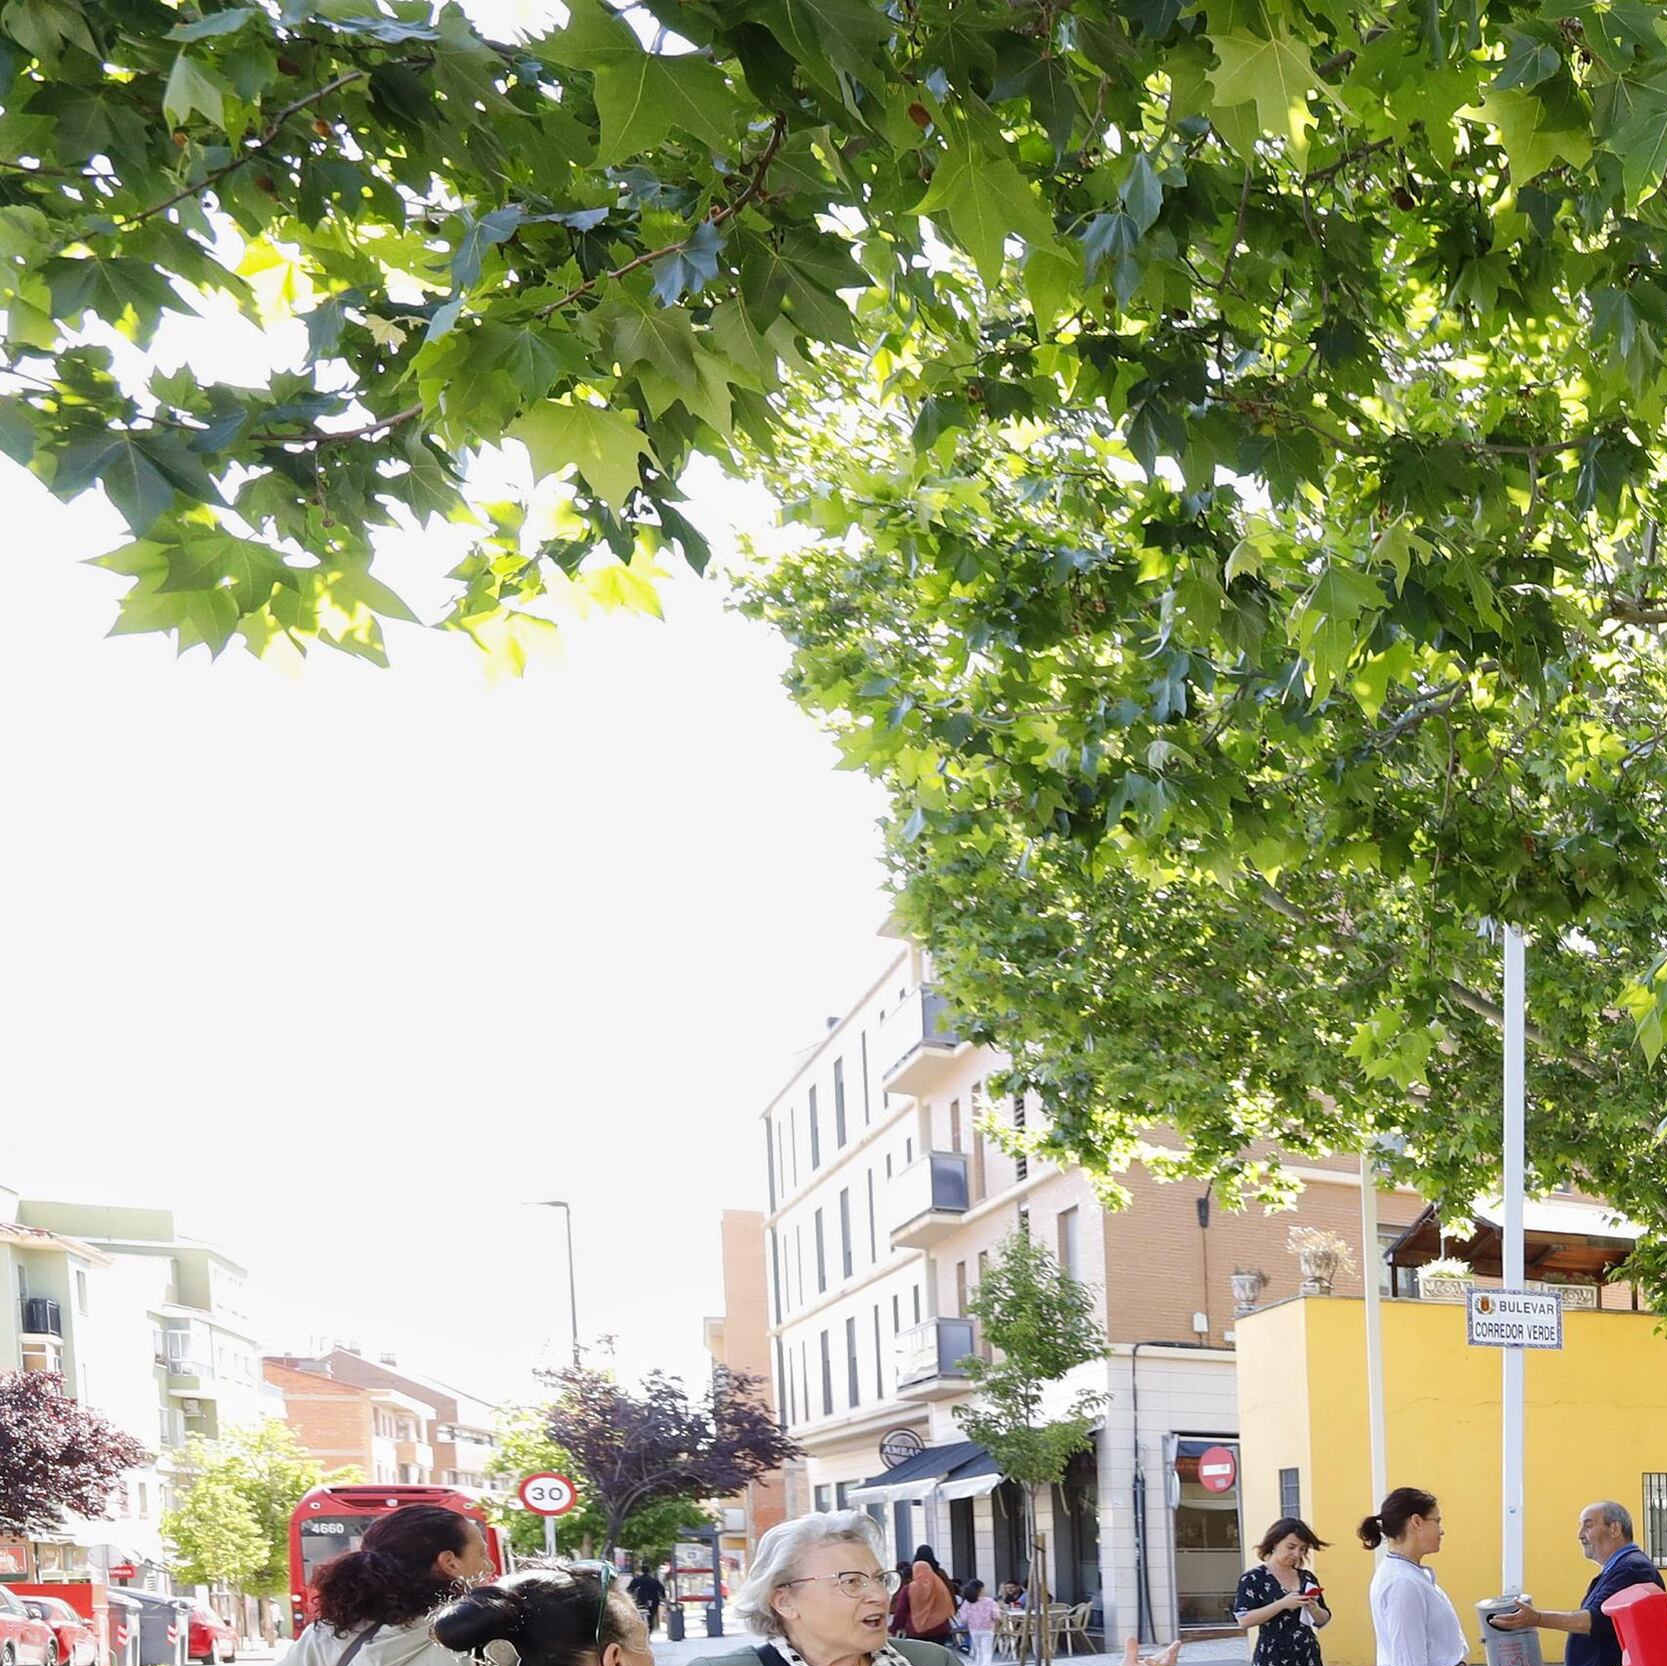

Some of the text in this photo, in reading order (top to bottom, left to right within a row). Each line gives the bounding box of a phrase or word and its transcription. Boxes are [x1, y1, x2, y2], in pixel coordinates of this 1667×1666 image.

[1500, 1301, 1554, 1315] BULEVAR
[1475, 1322, 1555, 1340] CORREDOR VERDE
[532, 1487, 563, 1501] 30
[311, 1523, 345, 1534] 4660
